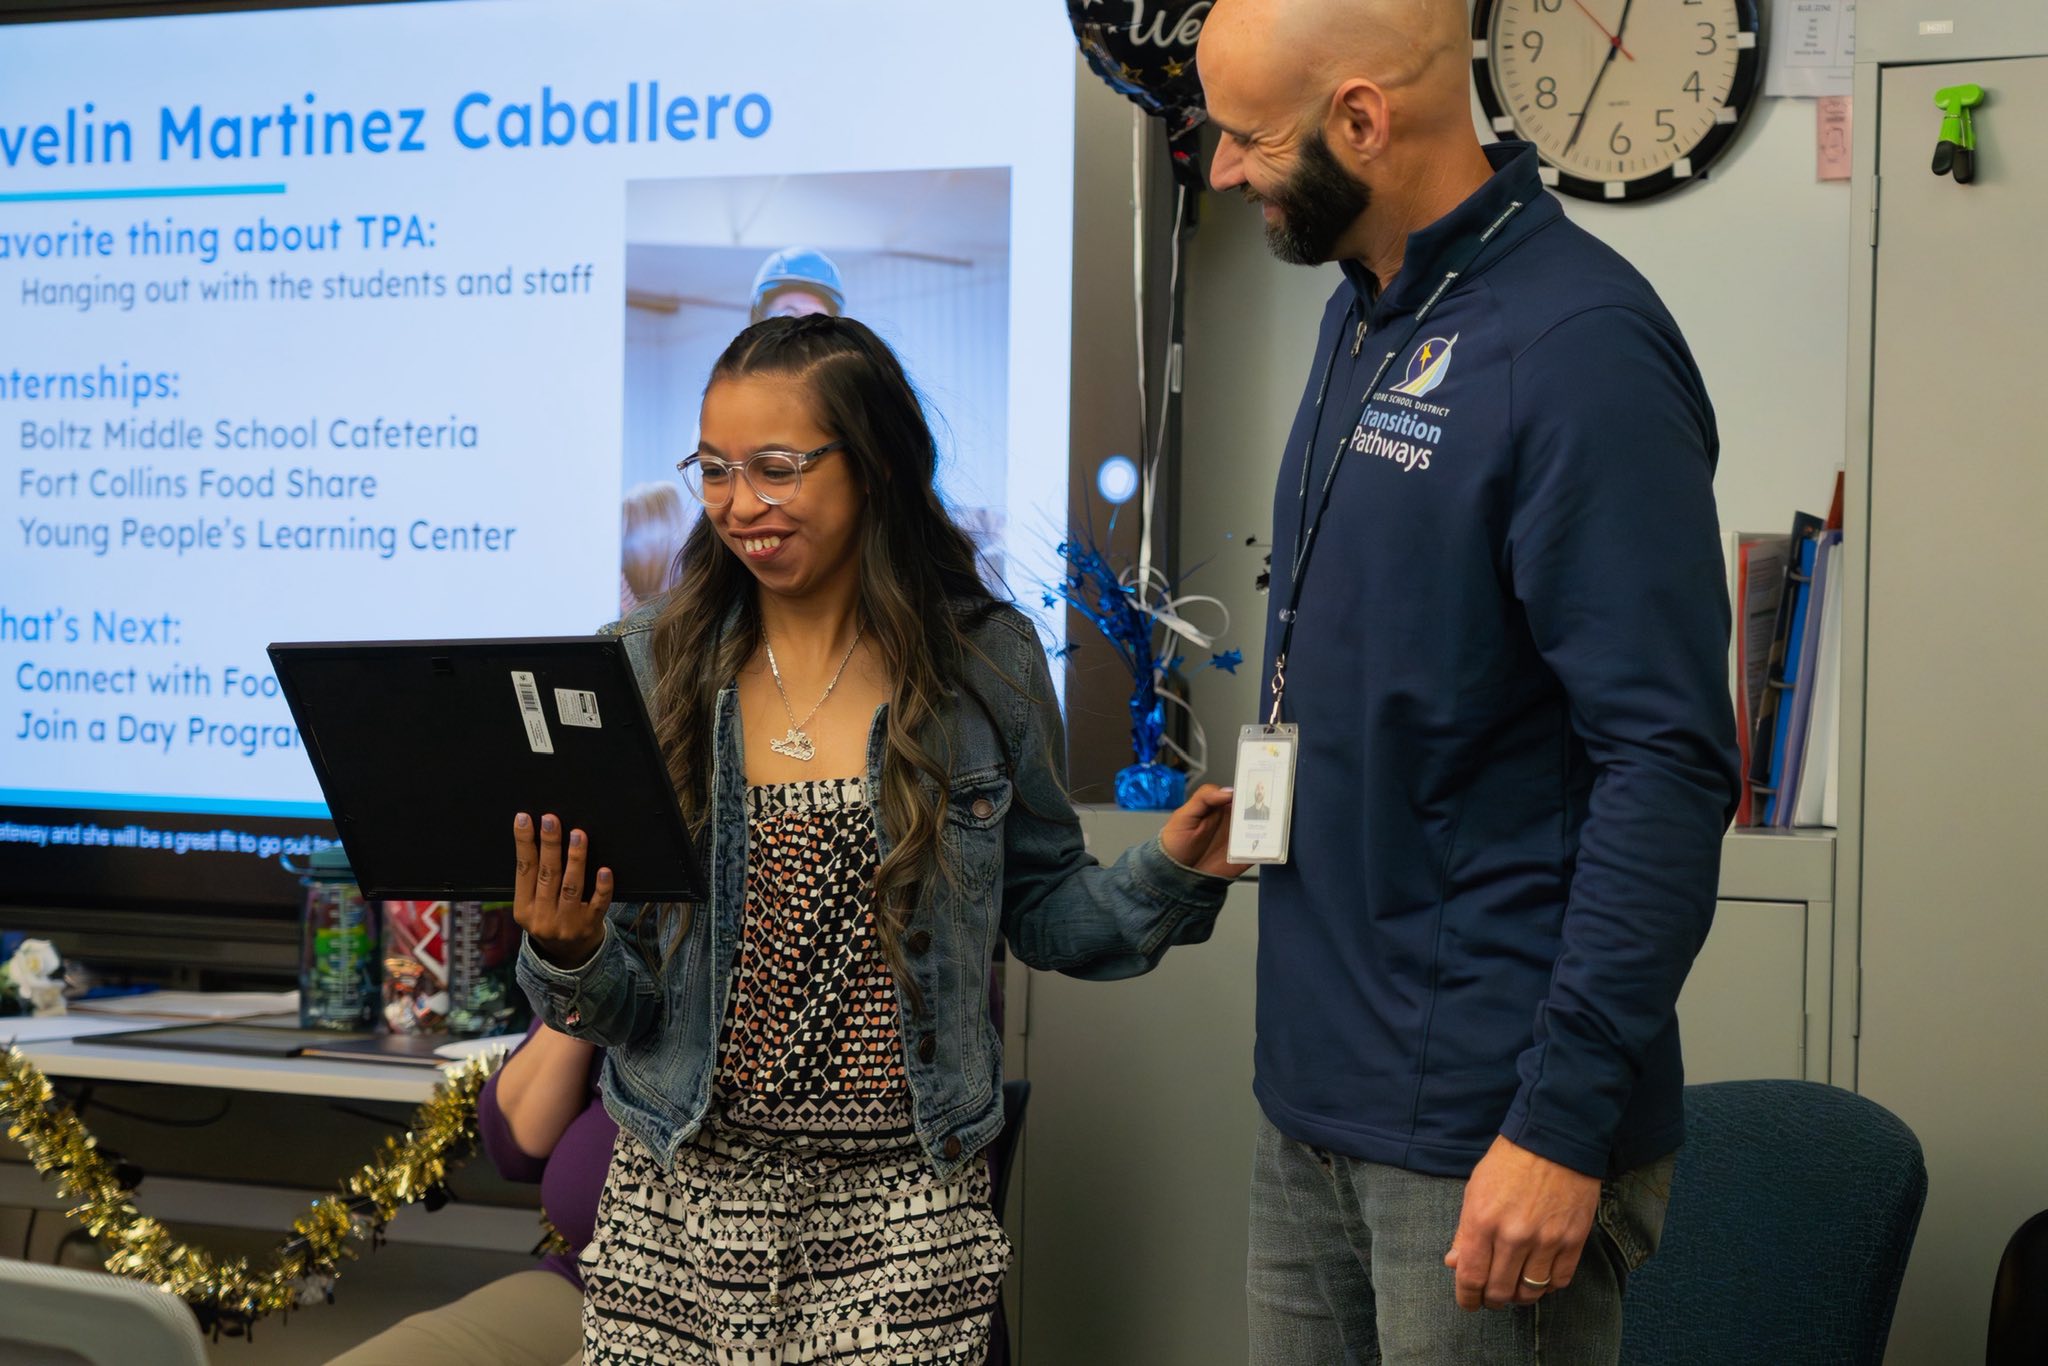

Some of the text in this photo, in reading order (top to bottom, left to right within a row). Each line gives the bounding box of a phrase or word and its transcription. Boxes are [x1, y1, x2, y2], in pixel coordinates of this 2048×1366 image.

[1522, 30, 1544, 63] 9
[1695, 22, 1717, 55] 3
[1536, 77, 1558, 110] 8
[1682, 70, 1705, 102] 4
[0, 82, 772, 167] velin Martinez Caballero
[1609, 122, 1632, 155] 6
[1655, 109, 1676, 142] 5
[129, 219, 220, 265] thing
[235, 219, 342, 253] about
[357, 216, 436, 249] TPA:
[23, 265, 593, 313] Hanging out with the students and staff
[1389, 394, 1413, 408] SCHOOL
[1415, 401, 1451, 417] DISTRICT
[22, 417, 478, 451] Boltz Middle School Cafeteria
[1359, 403, 1442, 444] Transition
[1350, 425, 1433, 472] Pathways
[21, 468, 378, 499] Fort Collins Food Share
[20, 518, 110, 558] Young
[259, 518, 397, 560] Learning
[410, 520, 517, 552] Center
[94, 612, 181, 645] Next:
[17, 662, 137, 694] Connect
[149, 665, 212, 696] with
[18, 712, 78, 742] Join
[89, 721, 107, 743] a
[119, 715, 177, 753] Day
[51, 823, 81, 844] and
[83, 824, 109, 846] she
[113, 825, 137, 847] will
[140, 826, 160, 848] be
[162, 832, 173, 849] a
[175, 829, 216, 855] great
[239, 832, 256, 853] to
[258, 835, 280, 858] go
